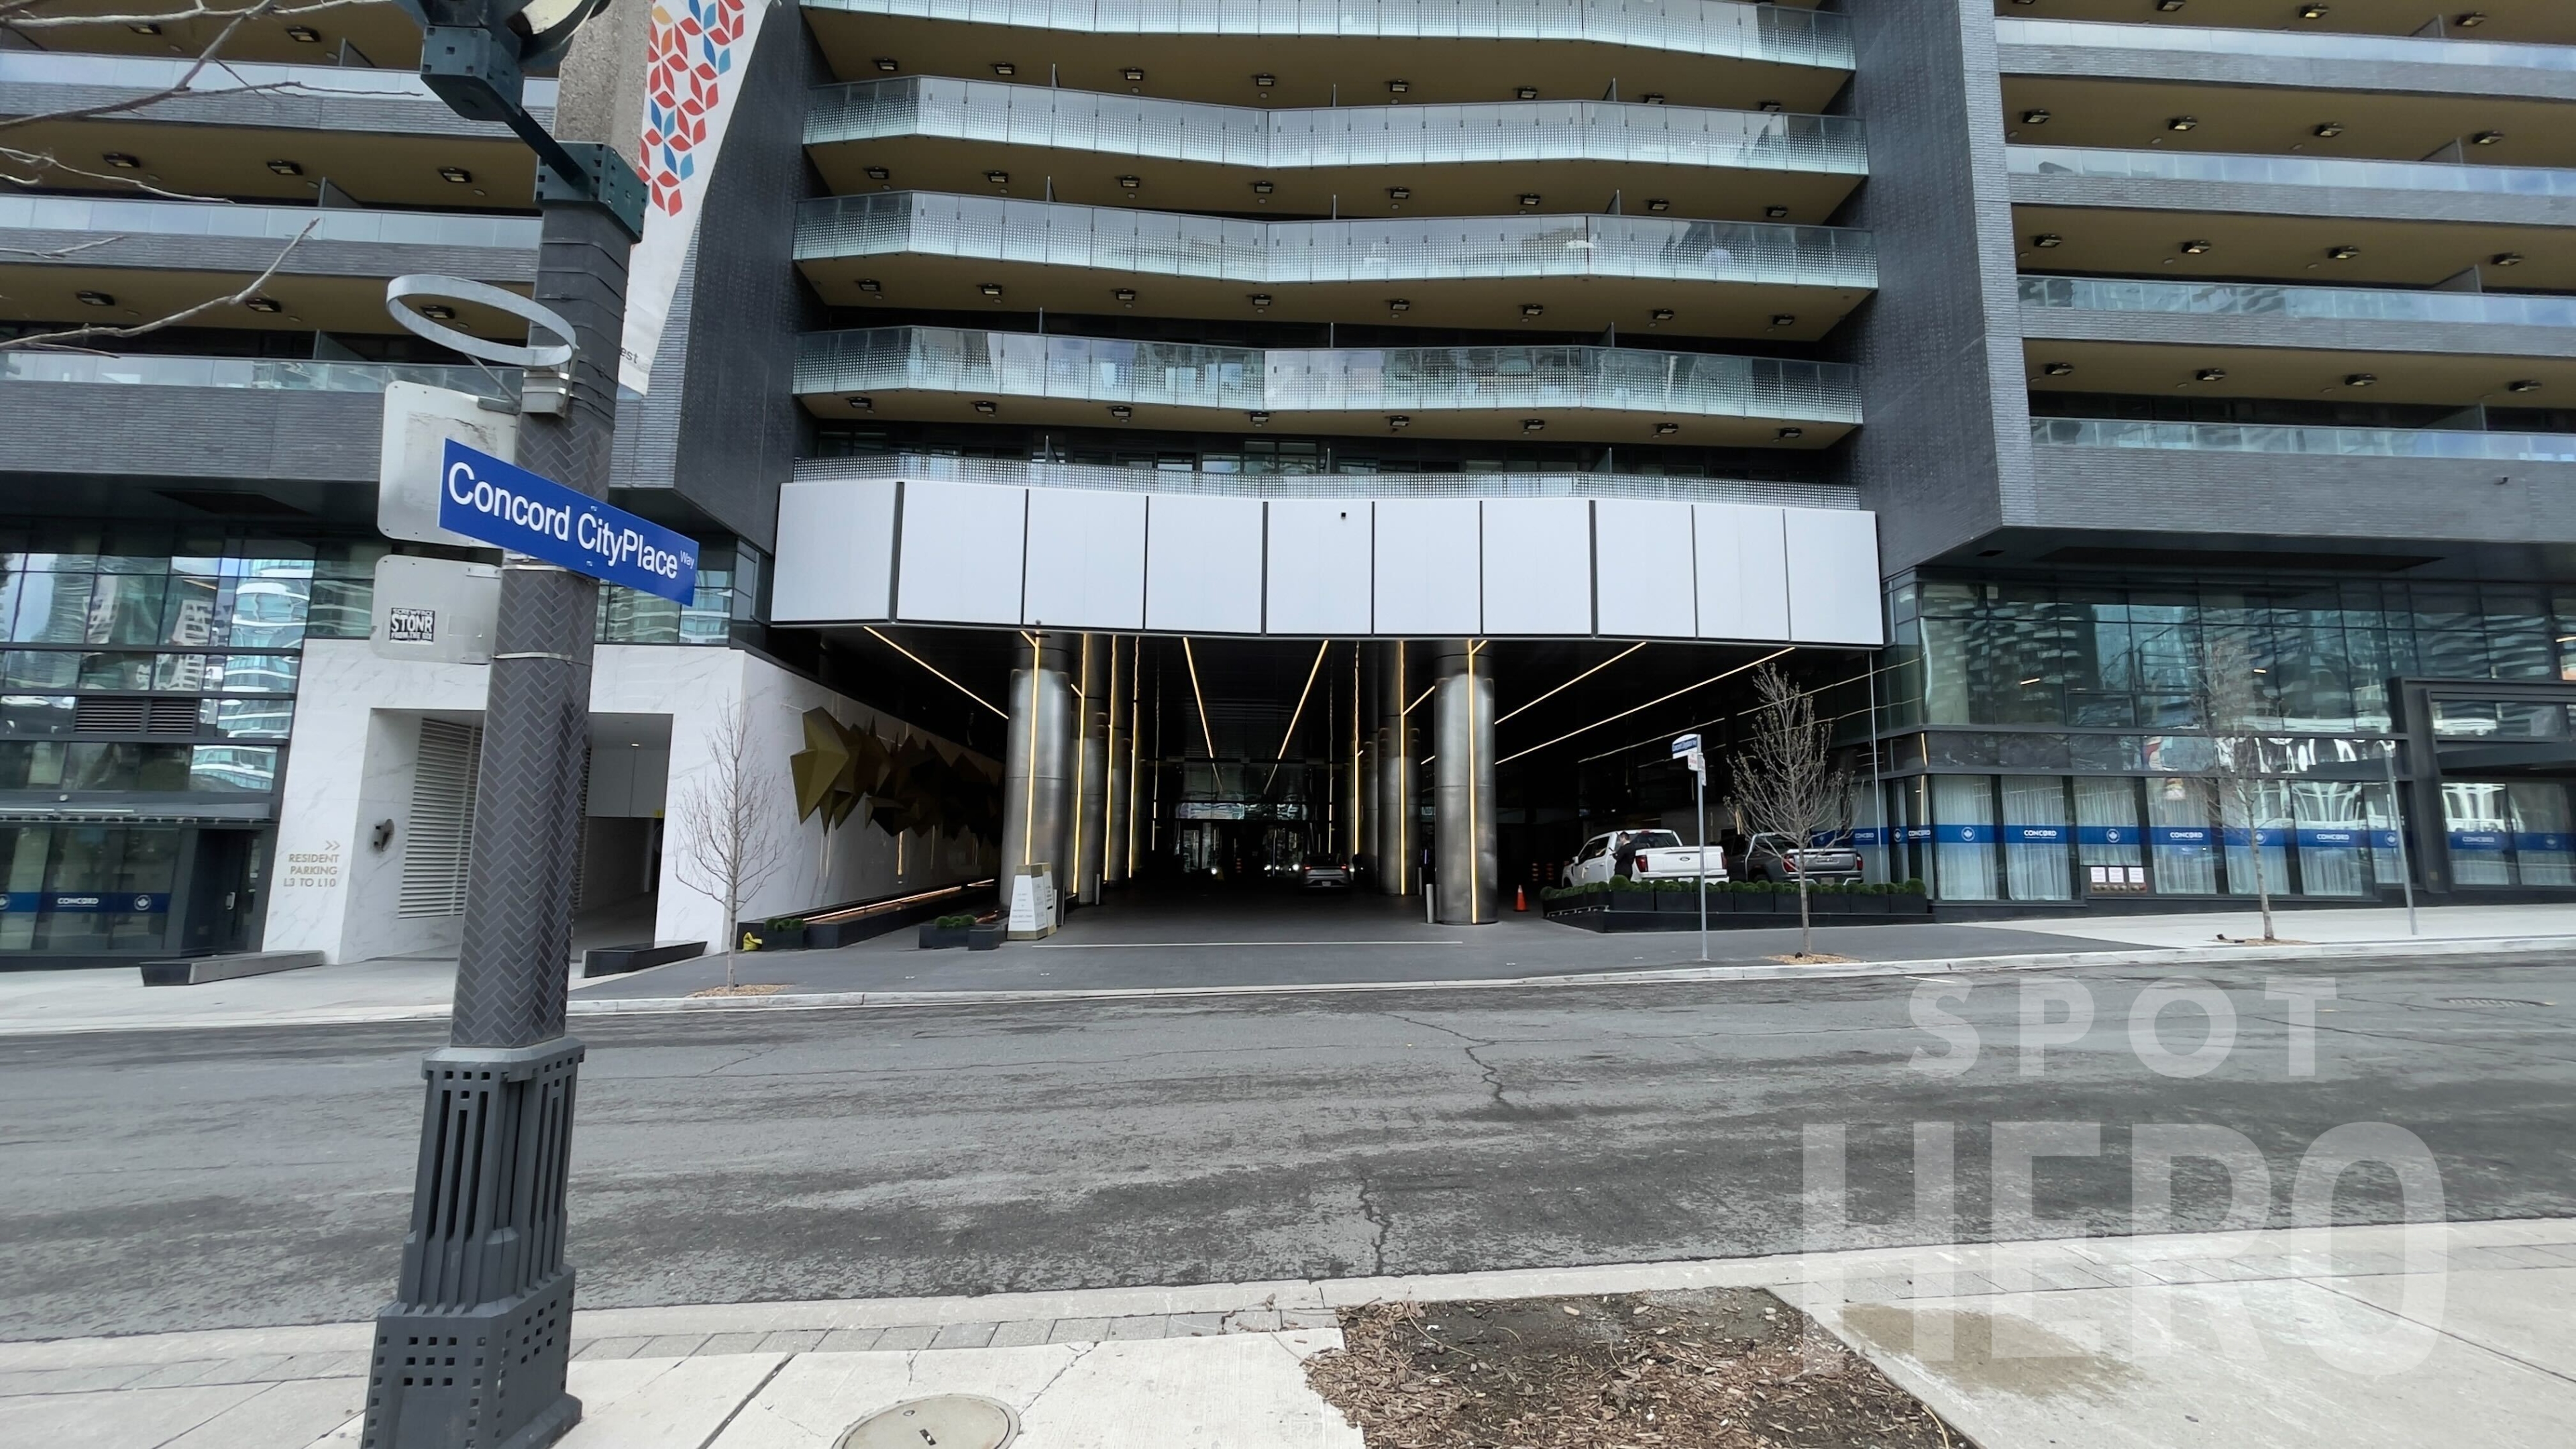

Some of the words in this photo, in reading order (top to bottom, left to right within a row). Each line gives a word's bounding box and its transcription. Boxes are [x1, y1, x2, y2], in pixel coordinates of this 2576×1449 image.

[448, 461, 571, 542] Concord
[578, 513, 678, 580] CityPlace
[680, 549, 695, 570] Way
[391, 613, 433, 633] STONR
[288, 853, 340, 863] RESIDENT
[290, 865, 338, 875] PARKING
[283, 877, 295, 888] L3
[300, 877, 314, 888] TO
[318, 877, 337, 888] L10
